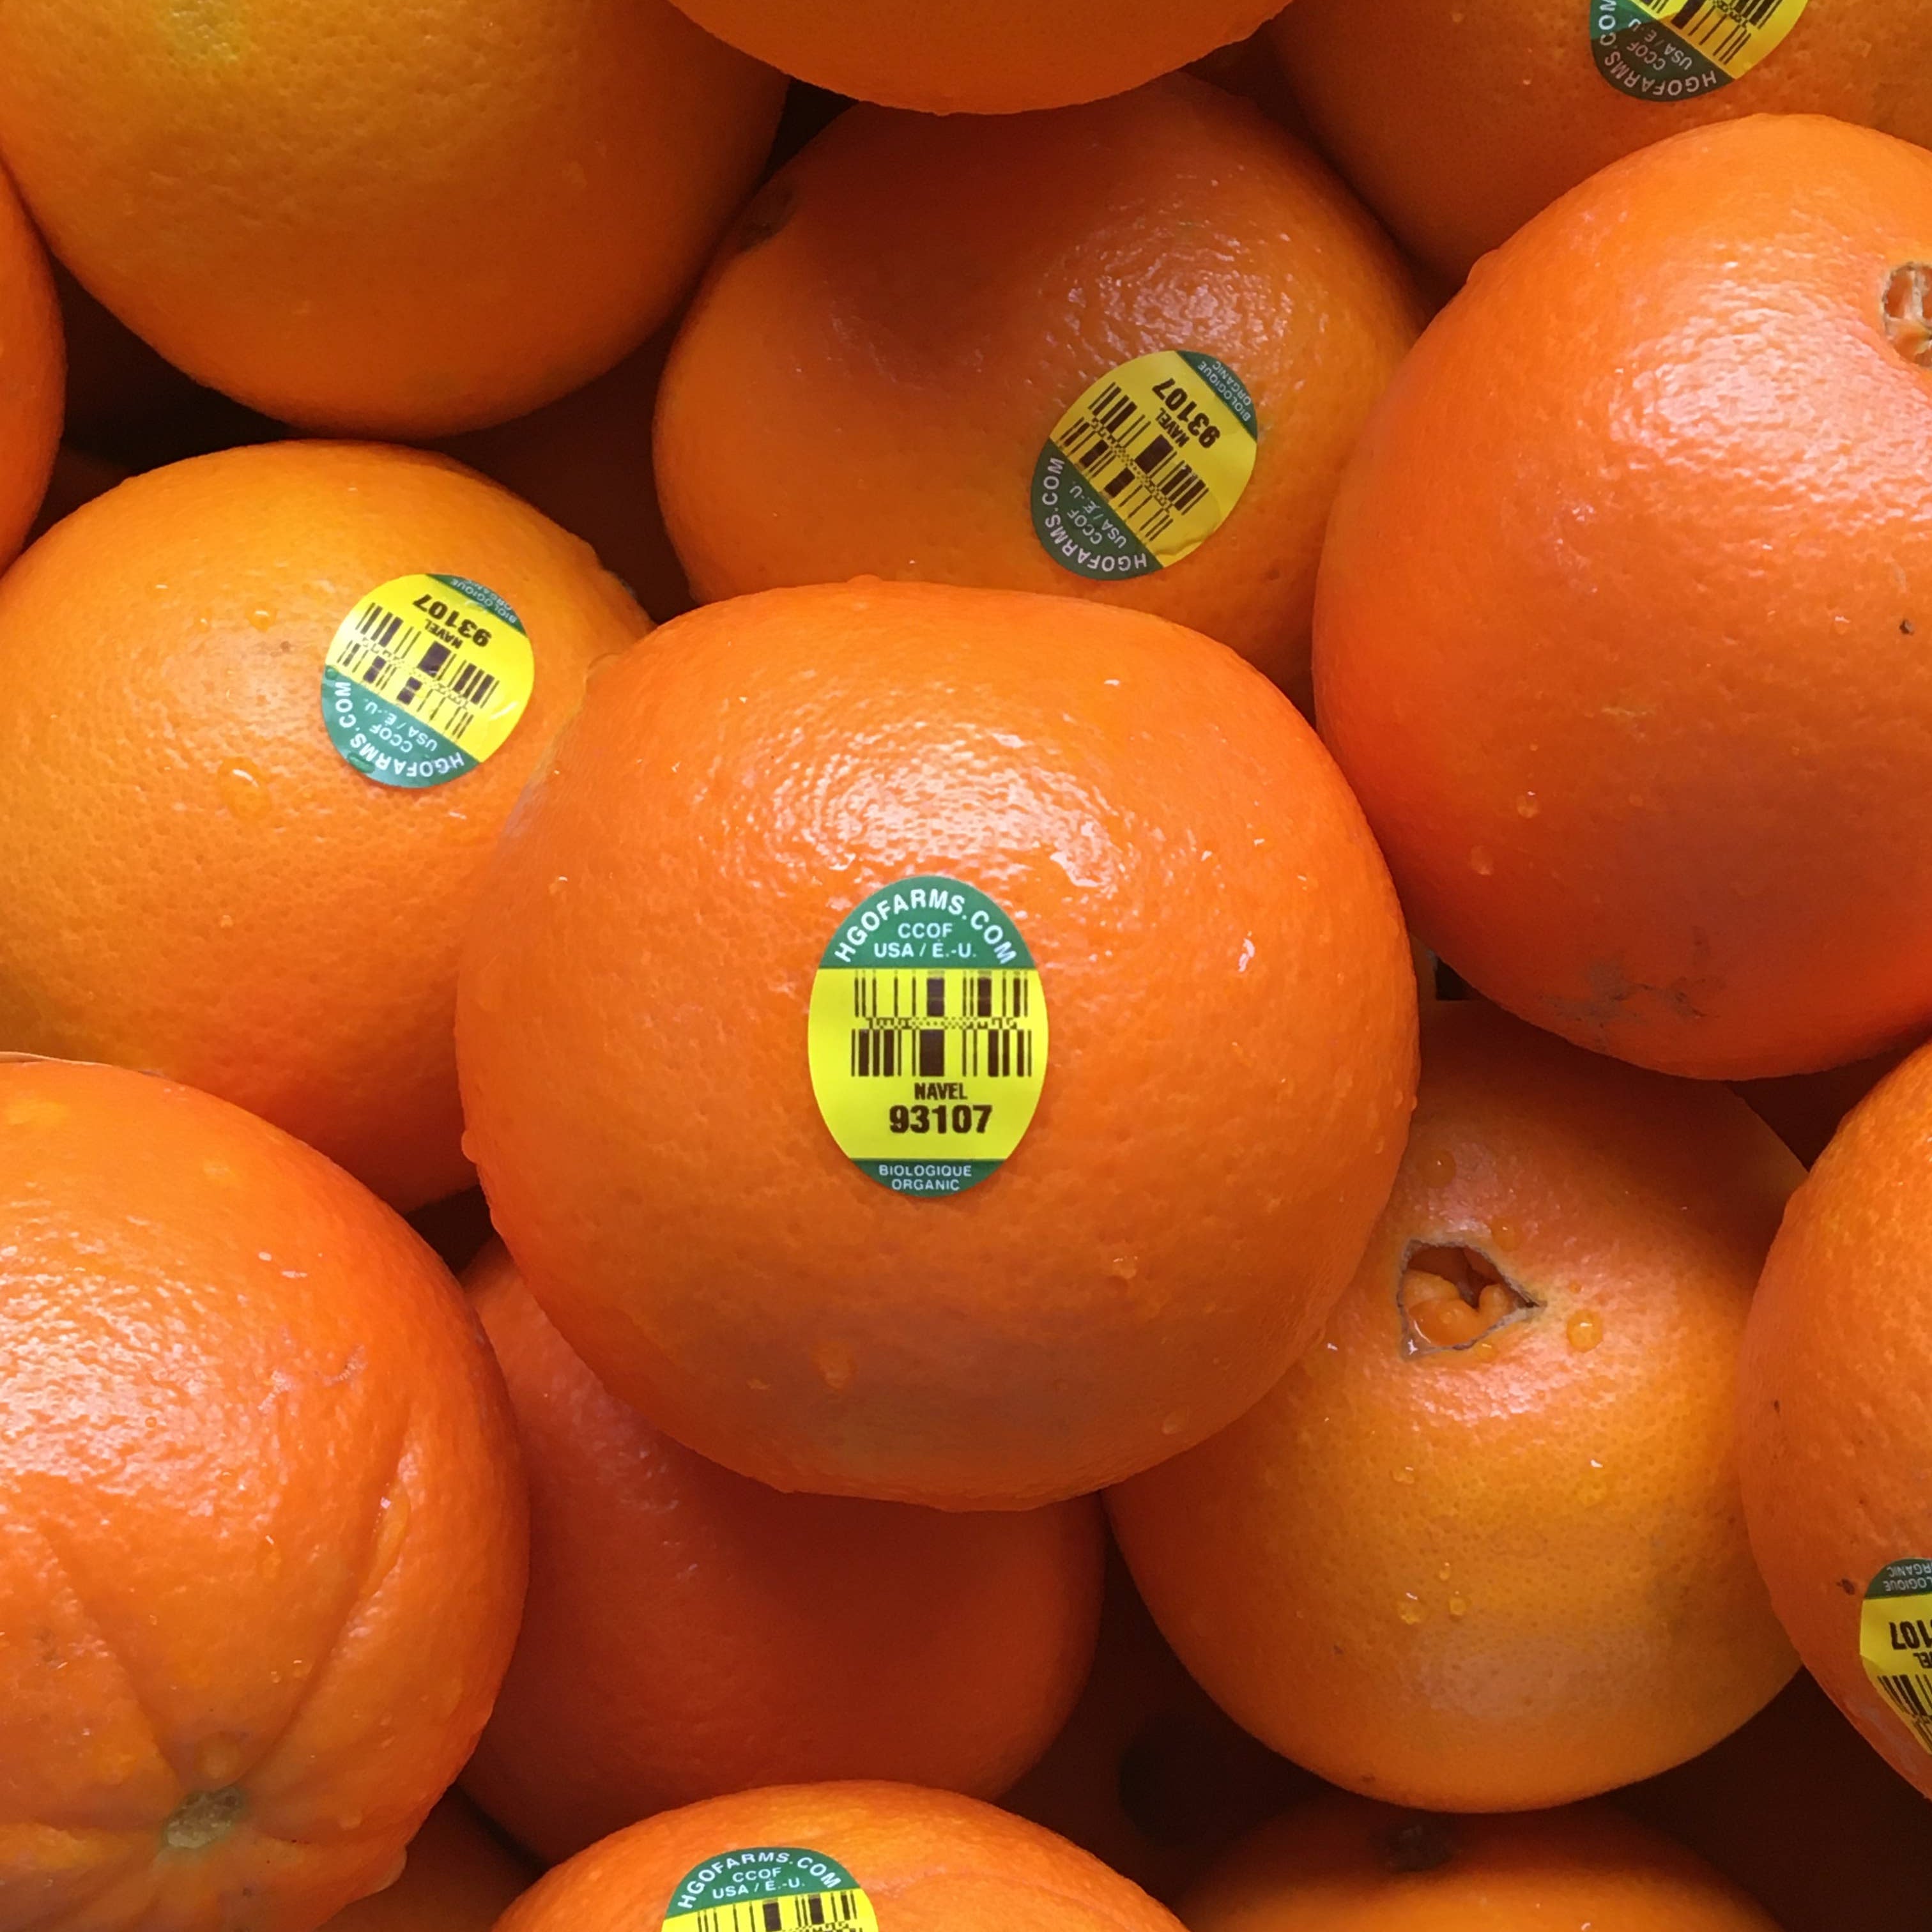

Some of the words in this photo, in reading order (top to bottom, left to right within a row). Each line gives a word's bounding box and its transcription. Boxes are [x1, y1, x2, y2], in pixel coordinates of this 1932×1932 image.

[1626, 41, 1666, 71] CCOF
[1663, 43, 1692, 70] USA
[1197, 360, 1252, 422] BIOLOGIQUE
[1211, 360, 1252, 407] ORGANIC
[1151, 377, 1221, 448] 93107
[1154, 406, 1190, 448] NAVEL
[1041, 457, 1148, 572] HGOFARMS.COM
[1066, 508, 1103, 544] CCOF
[1100, 518, 1127, 549] USA
[450, 578, 518, 624] BIOLOGIQUE
[412, 593, 493, 648] 93107
[424, 618, 463, 650] NAVEL
[334, 682, 465, 778] HGOFARMS.COM
[369, 723, 413, 753] CCOF
[407, 724, 438, 752] USA
[834, 888, 1017, 965] HGOFARMS.COM
[897, 922, 953, 939] CCOF
[873, 942, 914, 958] USA
[914, 1082, 968, 1100] NAVEL
[889, 1104, 993, 1134] 93107
[878, 1164, 972, 1177] BIOLOGIQUE
[891, 1177, 961, 1192] ORGANIC
[1888, 1619, 1932, 1651] 107
[677, 1851, 842, 1909] HGOFARMS.COM
[732, 1867, 782, 1883] CCOF
[712, 1885, 749, 1899] USA
